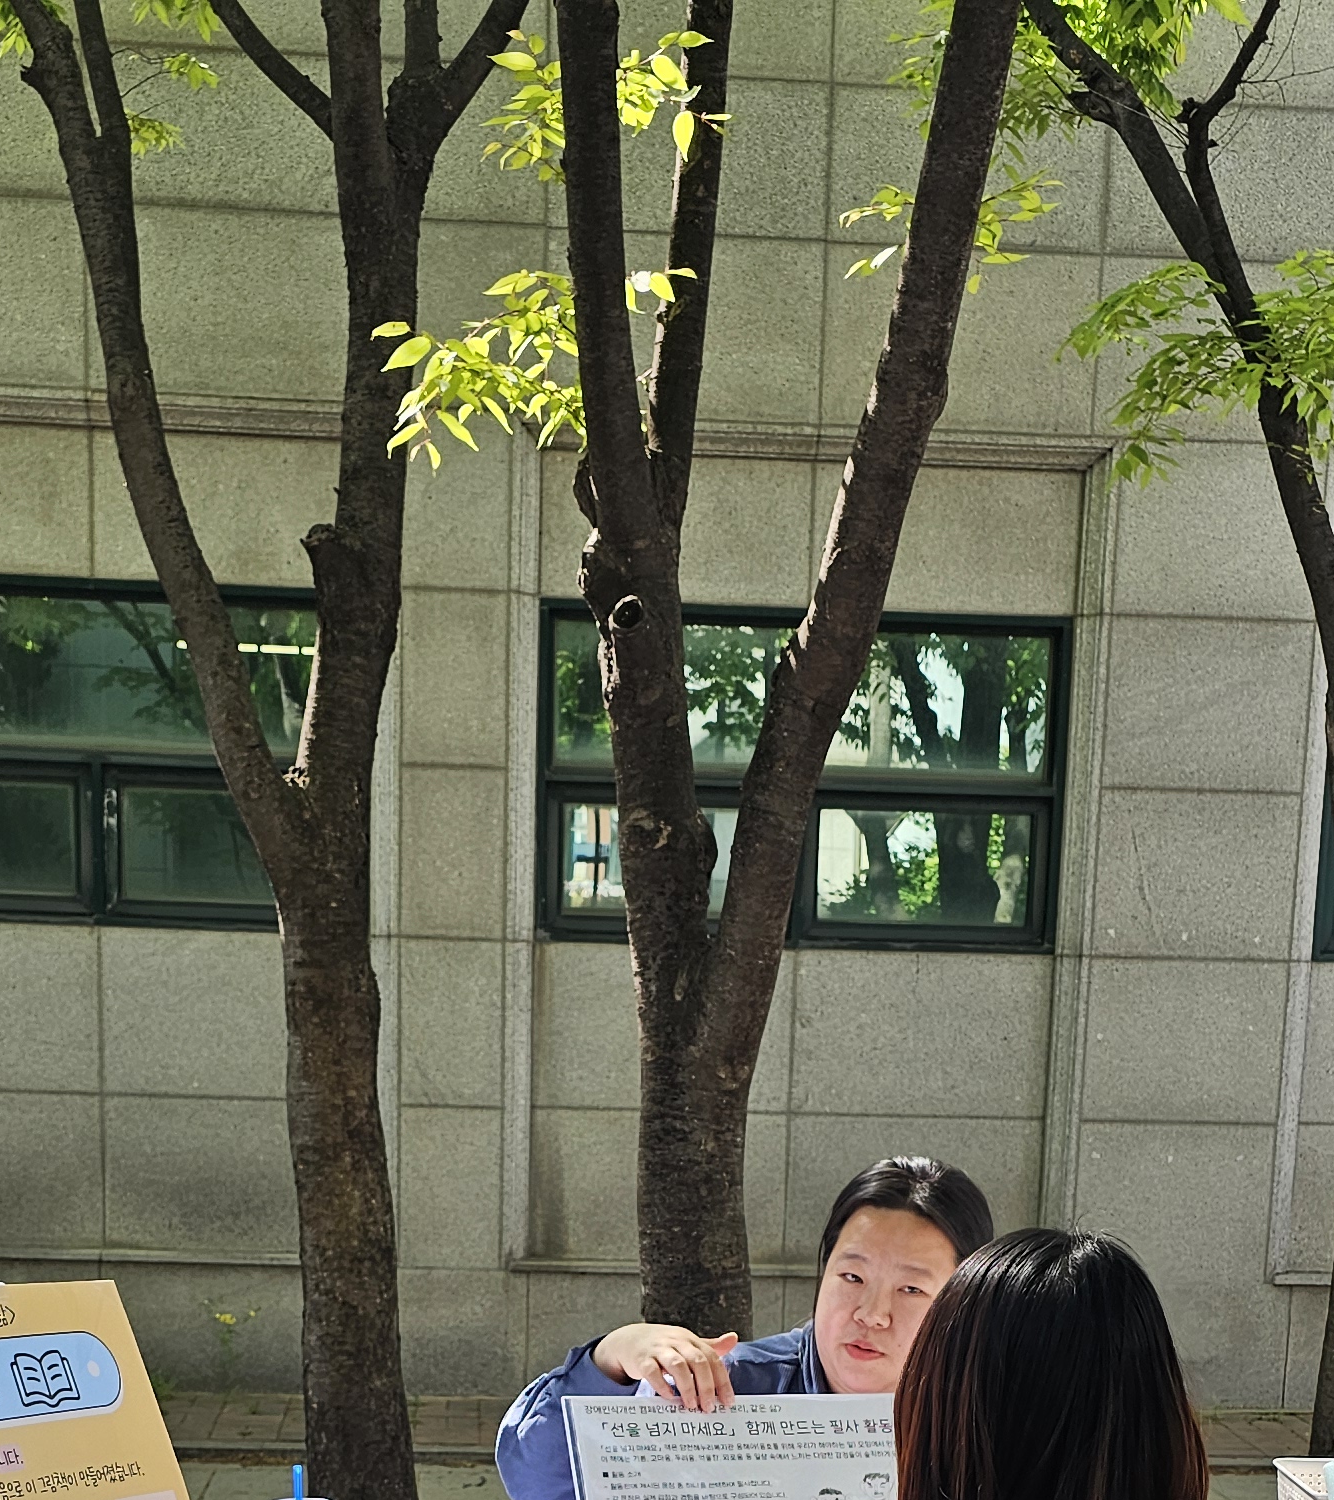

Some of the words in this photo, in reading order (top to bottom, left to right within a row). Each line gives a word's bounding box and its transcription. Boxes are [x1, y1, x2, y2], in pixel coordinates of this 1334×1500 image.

[646, 1422, 677, 1437] 넘지
[746, 1420, 777, 1437] 함께
[781, 1420, 826, 1436] 만드는
[830, 1419, 859, 1435] 필사
[864, 1417, 894, 1435] 활동
[24, 1478, 38, 1495] 이
[36, 1470, 79, 1494] 그림책이
[77, 1460, 146, 1488] 만들어졌습니다.
